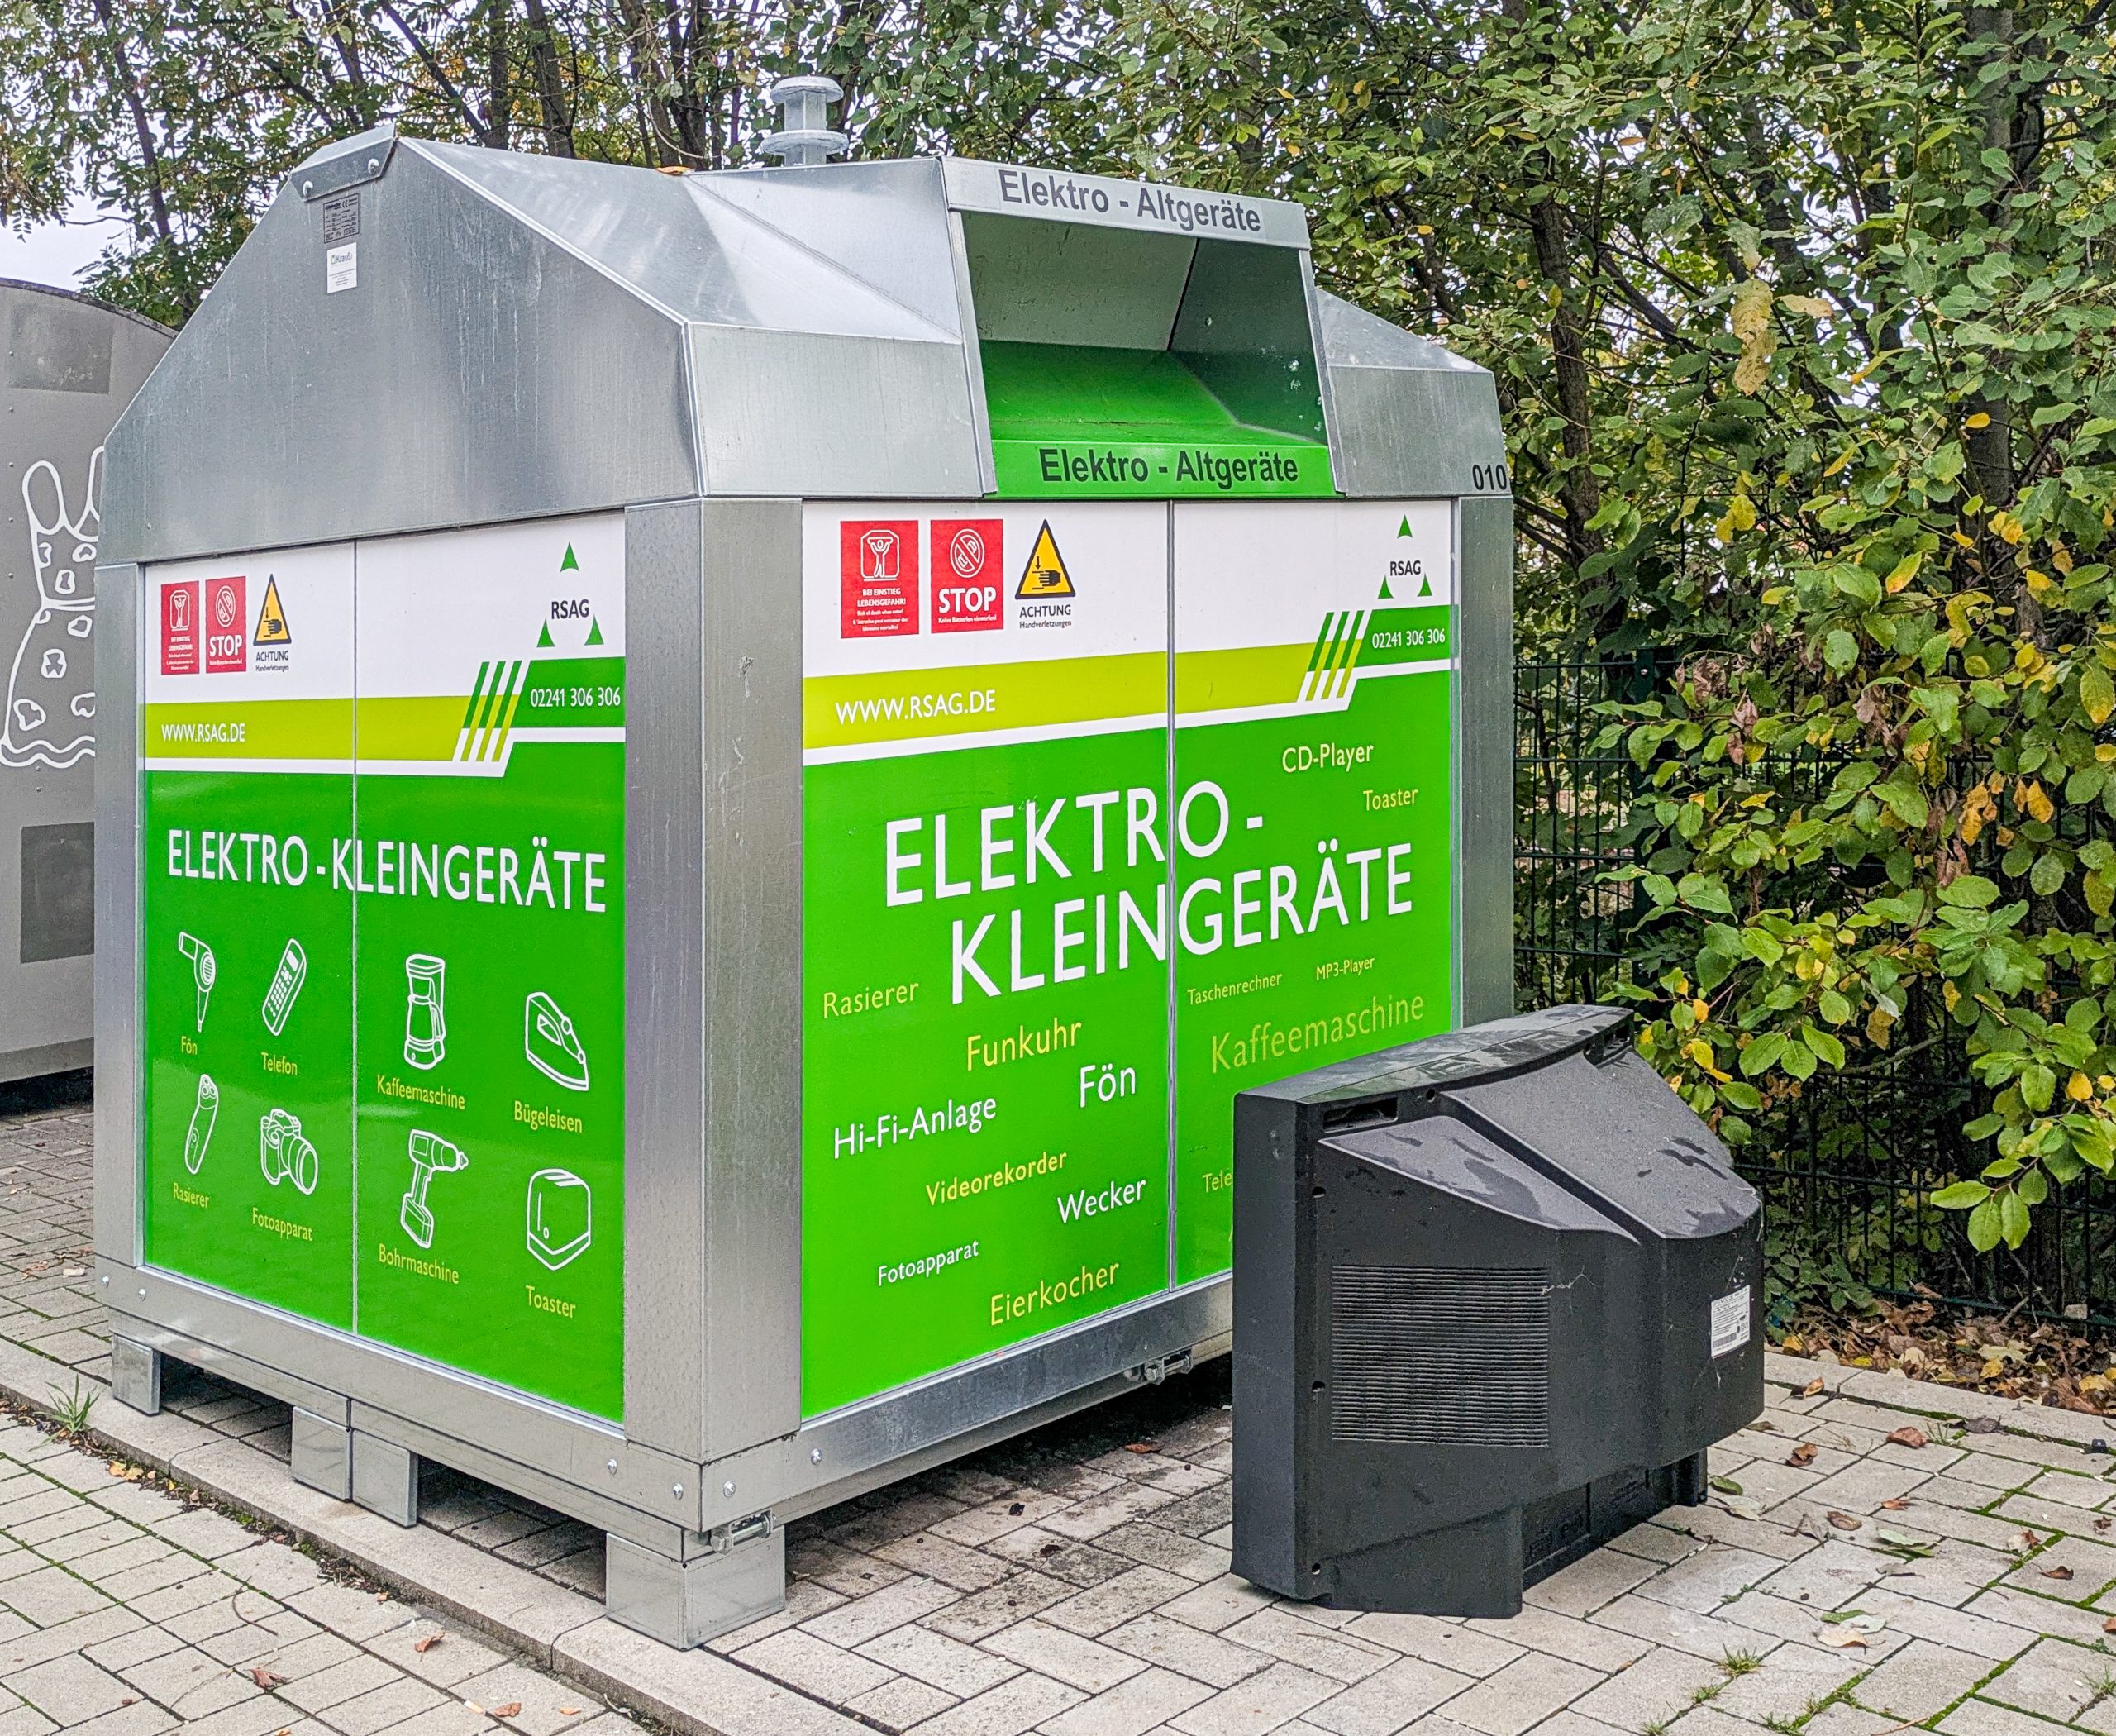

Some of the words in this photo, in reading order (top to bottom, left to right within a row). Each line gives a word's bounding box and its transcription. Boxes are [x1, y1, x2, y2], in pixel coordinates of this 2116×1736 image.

[998, 169, 1109, 213] Elektro
[1137, 187, 1261, 232] Altgeräte
[1039, 448, 1148, 482] Elektro
[1176, 449, 1299, 490] Altgeräte
[1472, 464, 1508, 490] 010
[1389, 560, 1421, 576] RSAG
[551, 599, 589, 619] RSAG
[938, 586, 997, 613] STOP
[1019, 604, 1071, 618] ACHTUNG
[1019, 620, 1072, 630] Handverletzungen
[1372, 632, 1402, 648] 02241
[1406, 630, 1424, 645] 306
[1427, 628, 1446, 643] 306
[209, 635, 242, 656] STOP
[255, 651, 288, 661] ACHTUNG
[530, 688, 565, 707] 02241
[570, 688, 593, 707] 306
[598, 687, 621, 706] 306
[835, 689, 996, 725] WWW.RSAG.DE
[161, 723, 245, 742] WWW.RSAG.DE
[1282, 742, 1374, 773] CD-Player
[1362, 788, 1418, 811] Toaster
[951, 838, 1413, 1004] KLEINGERÄTE
[1316, 957, 1375, 981] MP3-Player
[823, 982, 919, 1019] Rasierer
[1187, 973, 1282, 1005] Taschenrechner
[181, 1036, 198, 1055] Fön
[966, 1018, 1082, 1071] Funkuhr
[1212, 994, 1423, 1074] Kaffeemaschine
[261, 1052, 298, 1075] Telefon
[377, 1074, 465, 1110] Kaffeemaschine
[1079, 1062, 1137, 1108] Fön
[514, 1100, 583, 1133] Bügeleisen
[833, 1097, 996, 1159] Hi-Fi-Anlage
[173, 1182, 210, 1208] Rasierer
[926, 1152, 1067, 1206] Videorekorder
[1057, 1179, 1147, 1224] Wecker
[252, 1207, 313, 1241] Fotoapparat
[379, 1242, 460, 1285] Bohrmaschine
[878, 1240, 979, 1286] Fotoapparat
[525, 1285, 576, 1319] Toaster
[991, 1261, 1119, 1327] Eierkocher
